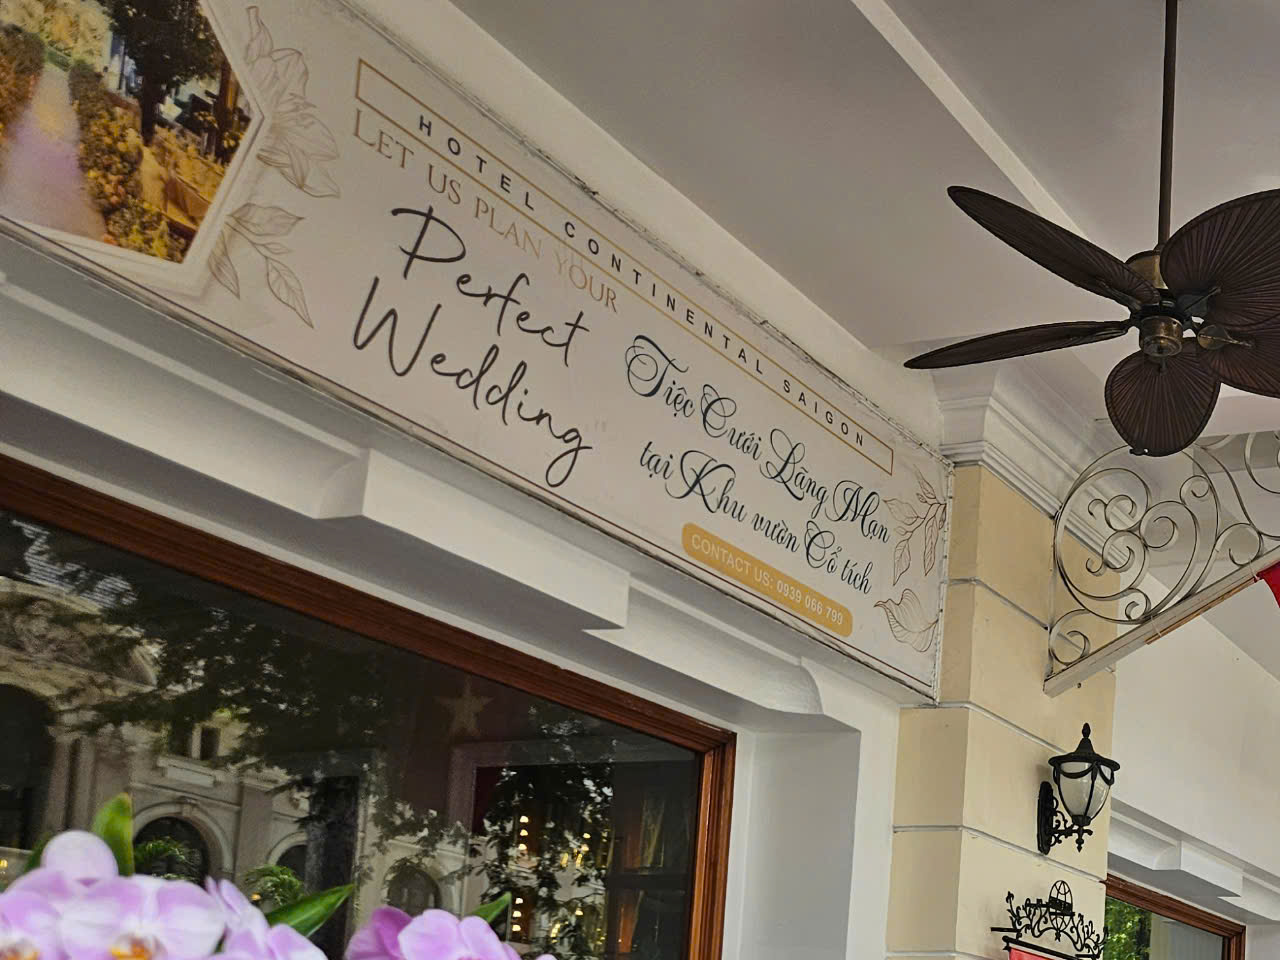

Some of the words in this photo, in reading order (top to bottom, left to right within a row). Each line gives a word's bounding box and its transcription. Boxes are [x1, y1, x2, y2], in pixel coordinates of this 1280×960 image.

[353, 108, 414, 170] LET
[427, 163, 461, 206] US
[473, 197, 542, 260] PLAN
[552, 250, 618, 314] YOUR
[390, 204, 591, 368] Perfect
[418, 114, 535, 211] HOTEL
[563, 220, 764, 375] CONTINENTAL
[782, 379, 864, 447] SAIGON
[353, 275, 593, 488] Wedding
[625, 334, 696, 418] Tiệc
[700, 383, 762, 461] Cưới
[759, 428, 830, 519] Lãng
[824, 479, 891, 544] Mạn
[639, 440, 675, 480] tại
[665, 449, 747, 522] Khu
[750, 511, 801, 553] vườn
[803, 519, 843, 574] Cổ
[840, 559, 873, 595] tích
[691, 533, 752, 576] CONTACT
[753, 568, 774, 590] US:
[776, 579, 802, 603] 0939
[825, 606, 844, 626] 799
